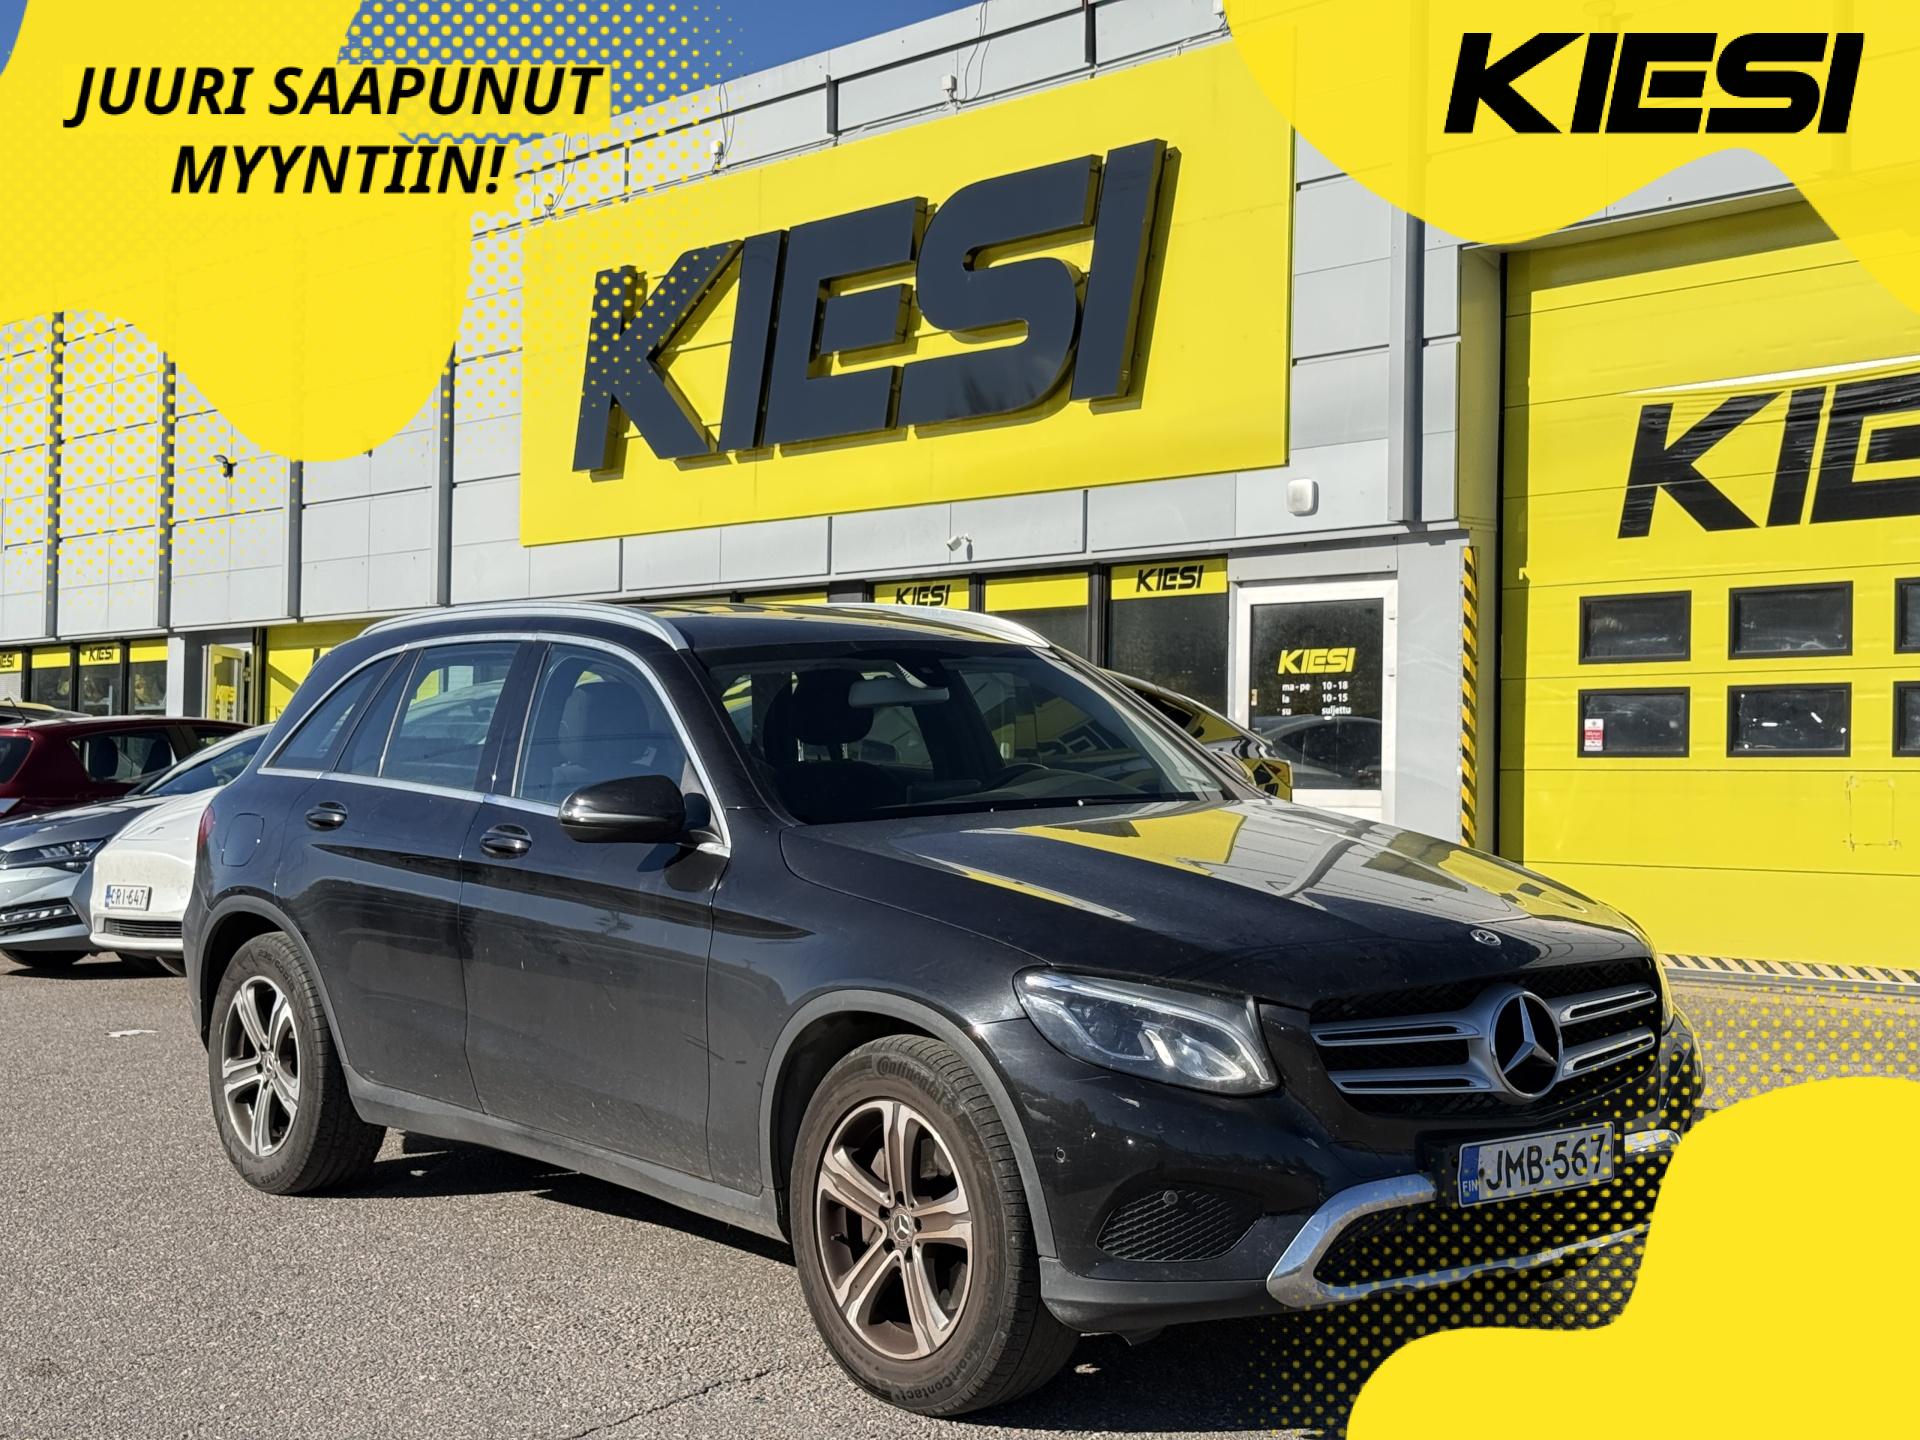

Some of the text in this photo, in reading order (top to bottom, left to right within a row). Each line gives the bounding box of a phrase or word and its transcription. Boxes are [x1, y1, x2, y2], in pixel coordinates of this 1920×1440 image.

[573, 139, 1168, 472] KIESI
[1135, 565, 1204, 592] KIESI
[895, 584, 951, 606] KIESI
[88, 645, 115, 662] KIESI
[1277, 647, 1356, 675] KIESI
[1281, 705, 1352, 717] su suljettu
[1486, 1133, 1607, 1191] JMB-567
[1462, 1177, 1479, 1193] FIN
